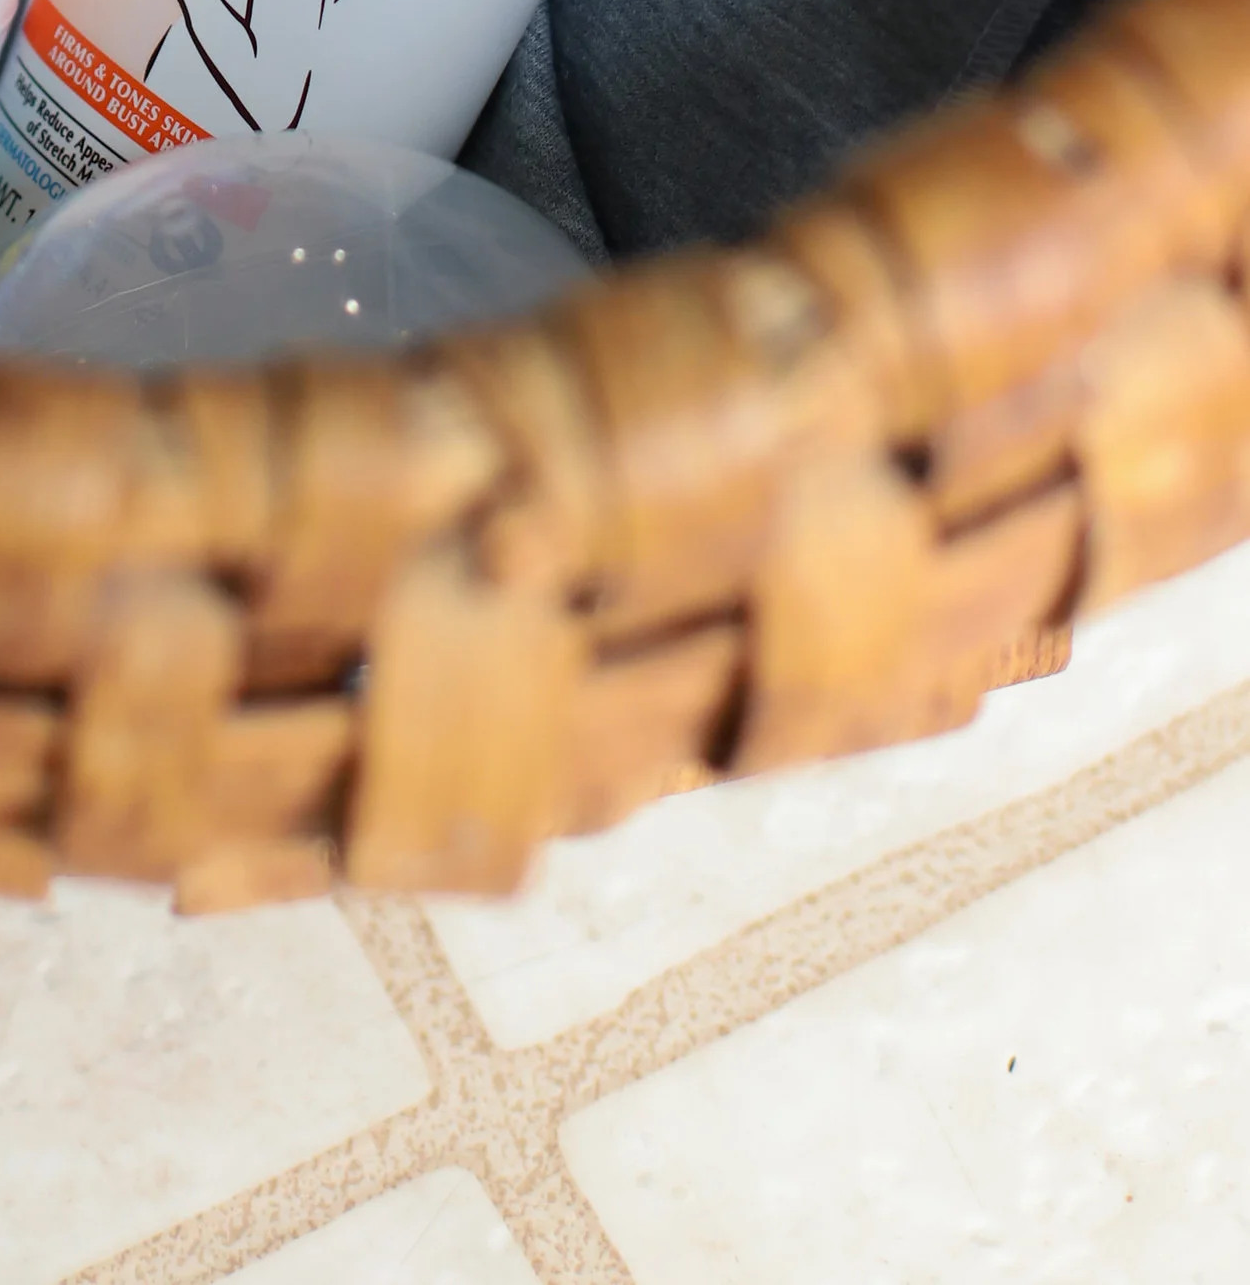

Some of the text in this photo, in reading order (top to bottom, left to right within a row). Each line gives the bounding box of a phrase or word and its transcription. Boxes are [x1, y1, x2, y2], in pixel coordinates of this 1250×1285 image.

[15, 73, 36, 106] Helps
[36, 100, 74, 143] Reduce
[48, 45, 106, 102] AROUND
[106, 98, 150, 136] BUST
[53, 24, 94, 68] FIRMS
[94, 63, 107, 81] &
[109, 72, 161, 122] TONES
[26, 120, 77, 174] of Stretch
